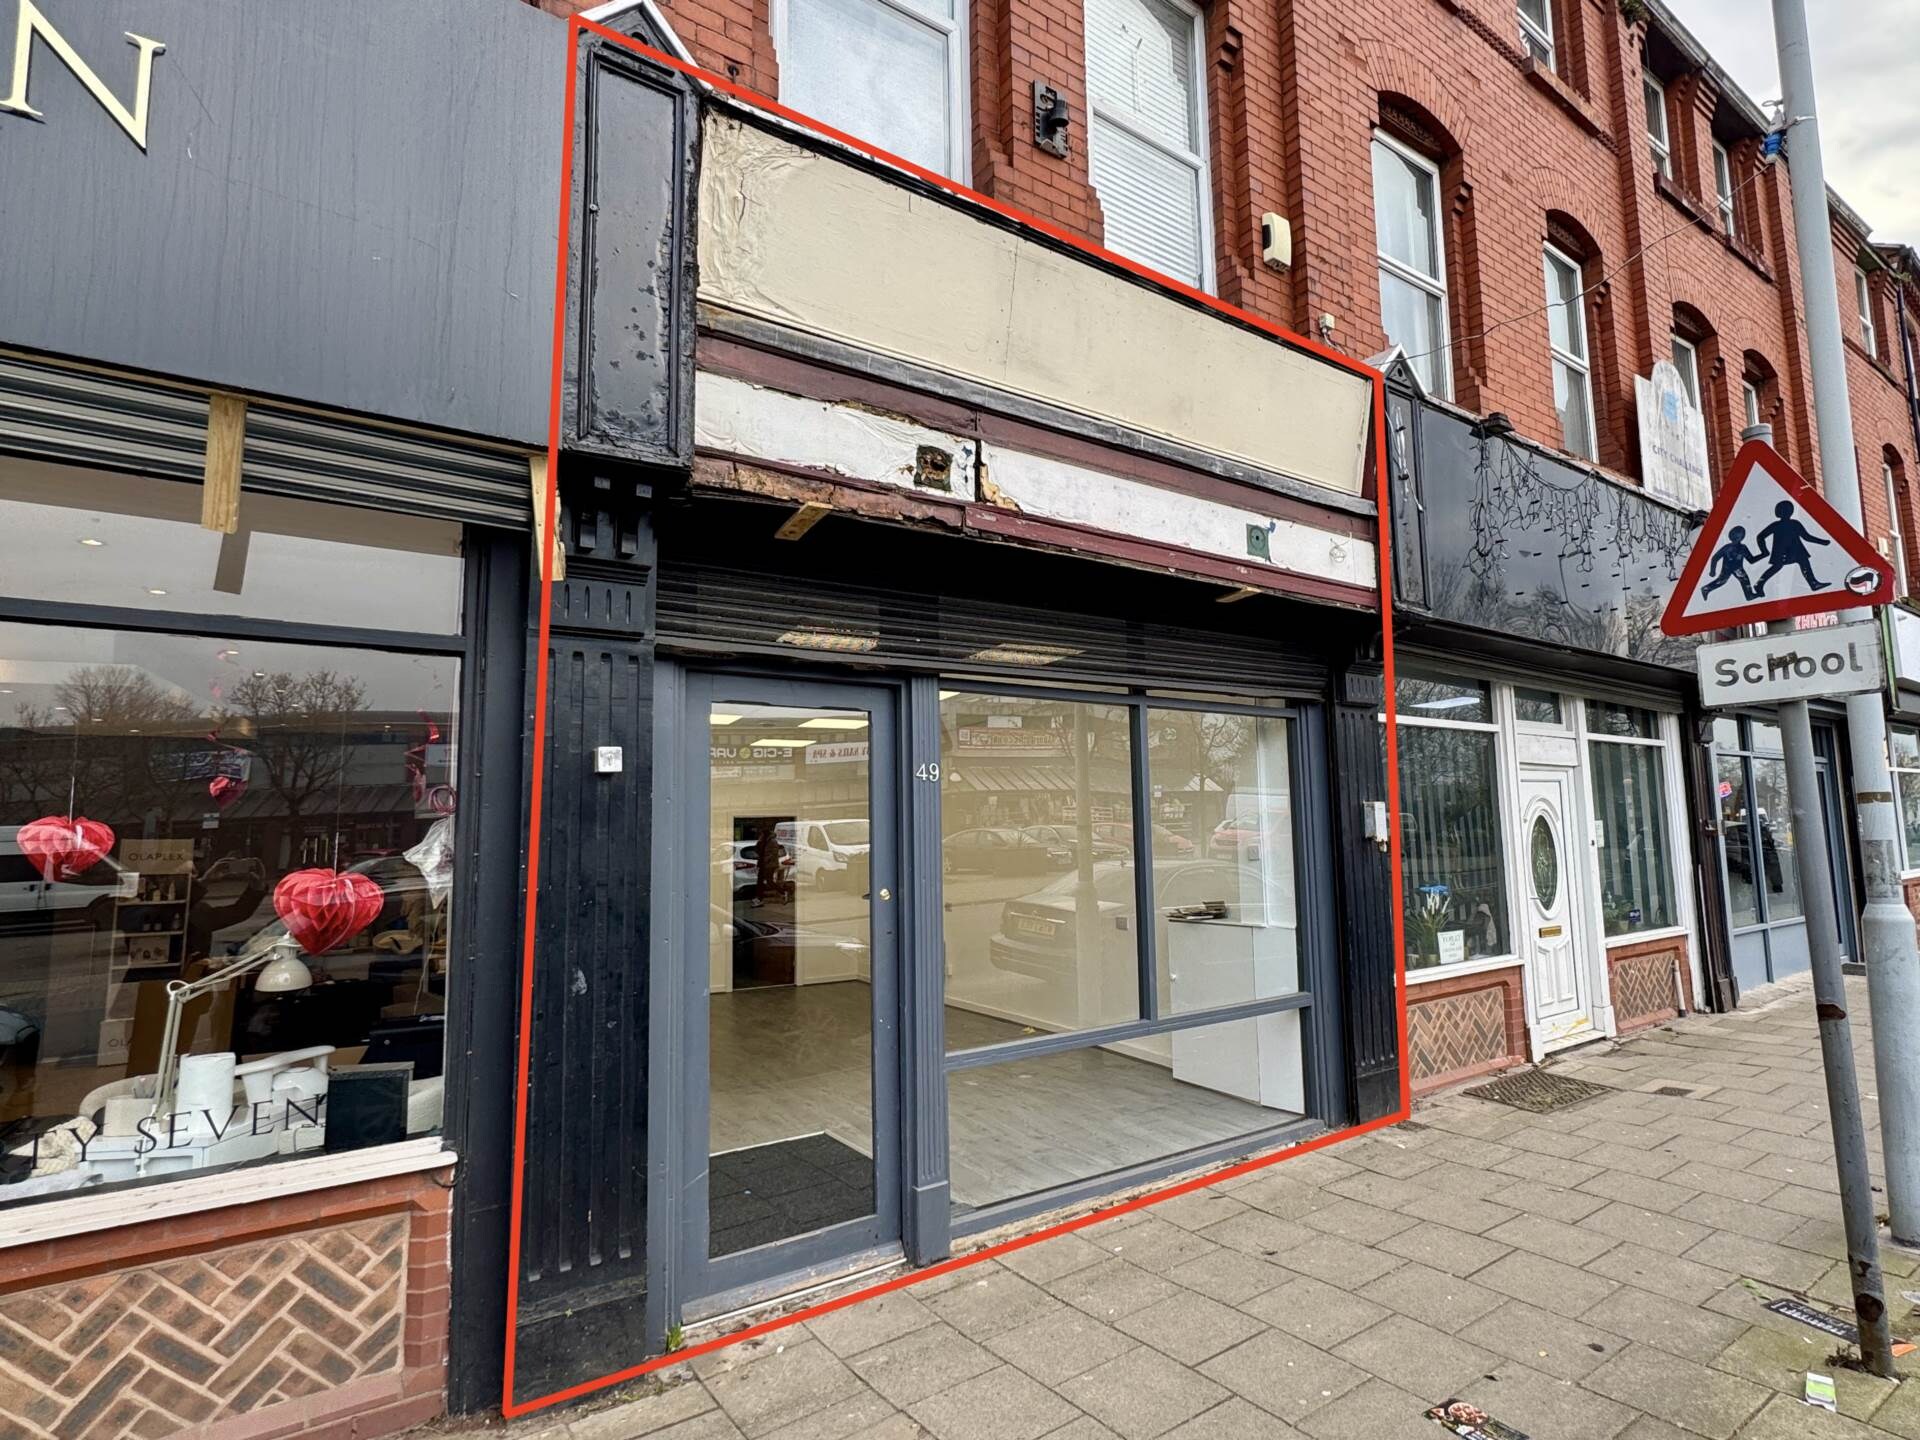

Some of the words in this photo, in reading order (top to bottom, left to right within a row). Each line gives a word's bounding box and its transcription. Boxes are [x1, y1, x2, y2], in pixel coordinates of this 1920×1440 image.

[0, 0, 166, 150] N
[1715, 642, 1863, 687] School
[916, 762, 940, 782] 49
[128, 852, 184, 861] OLAPLEX
[134, 1094, 327, 1154] SEVEN
